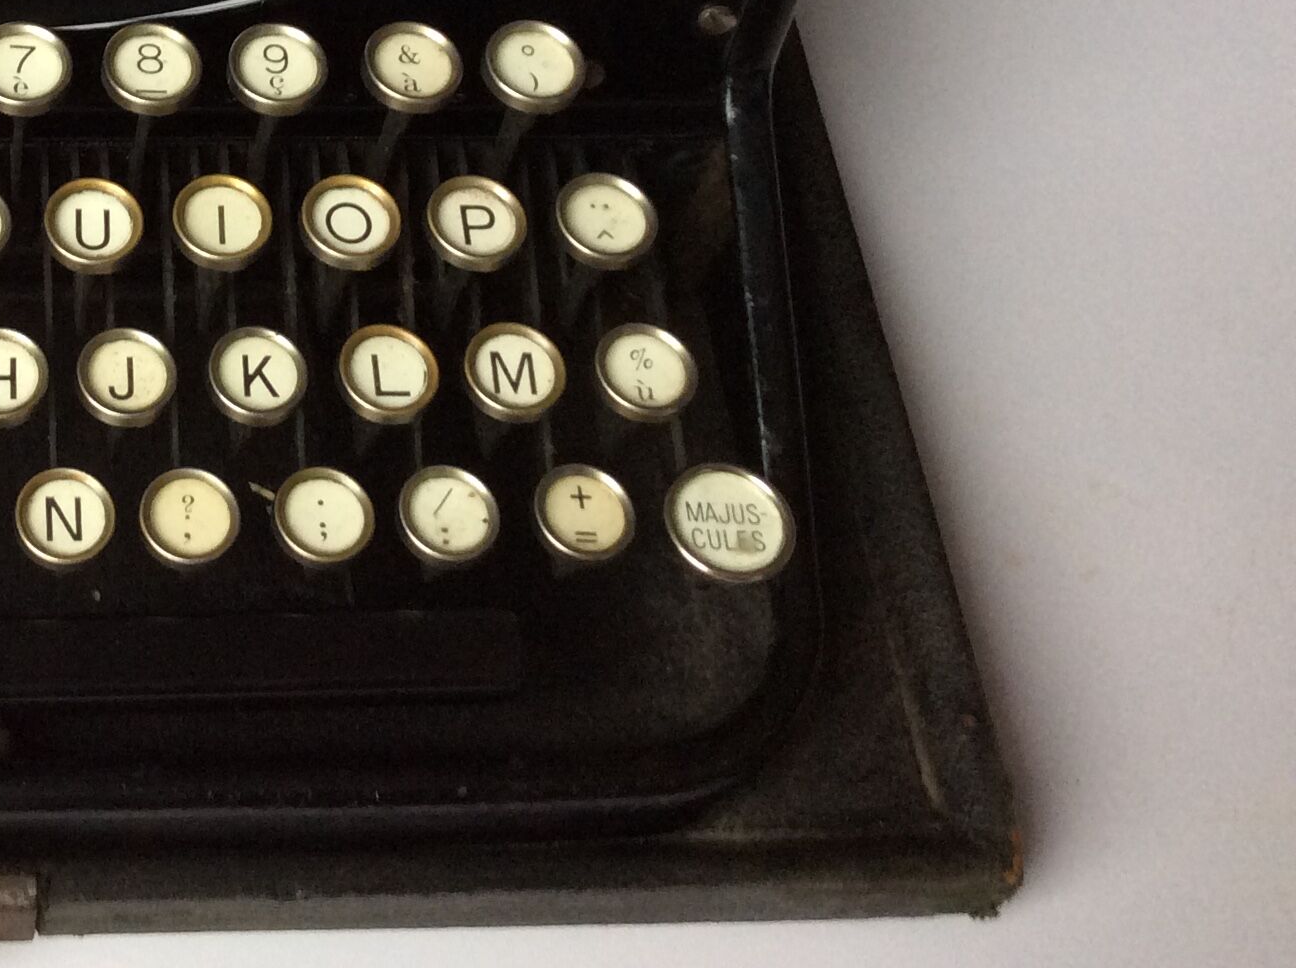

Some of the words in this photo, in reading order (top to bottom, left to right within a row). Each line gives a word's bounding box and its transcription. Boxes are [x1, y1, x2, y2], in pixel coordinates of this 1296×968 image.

[10, 45, 36, 73] 7
[137, 44, 163, 74] 8
[263, 44, 288, 74] 9
[399, 45, 420, 64] &
[402, 72, 421, 92] à
[76, 209, 110, 250] U
[218, 205, 225, 244] I
[326, 202, 372, 244] O
[460, 205, 495, 245] P
[109, 357, 134, 400] J
[242, 355, 279, 397] K
[371, 354, 411, 396] L
[490, 351, 537, 394] M
[630, 348, 653, 371] %
[570, 486, 592, 509] +
[685, 500, 768, 525] MAJUS-
[46, 497, 82, 541] N
